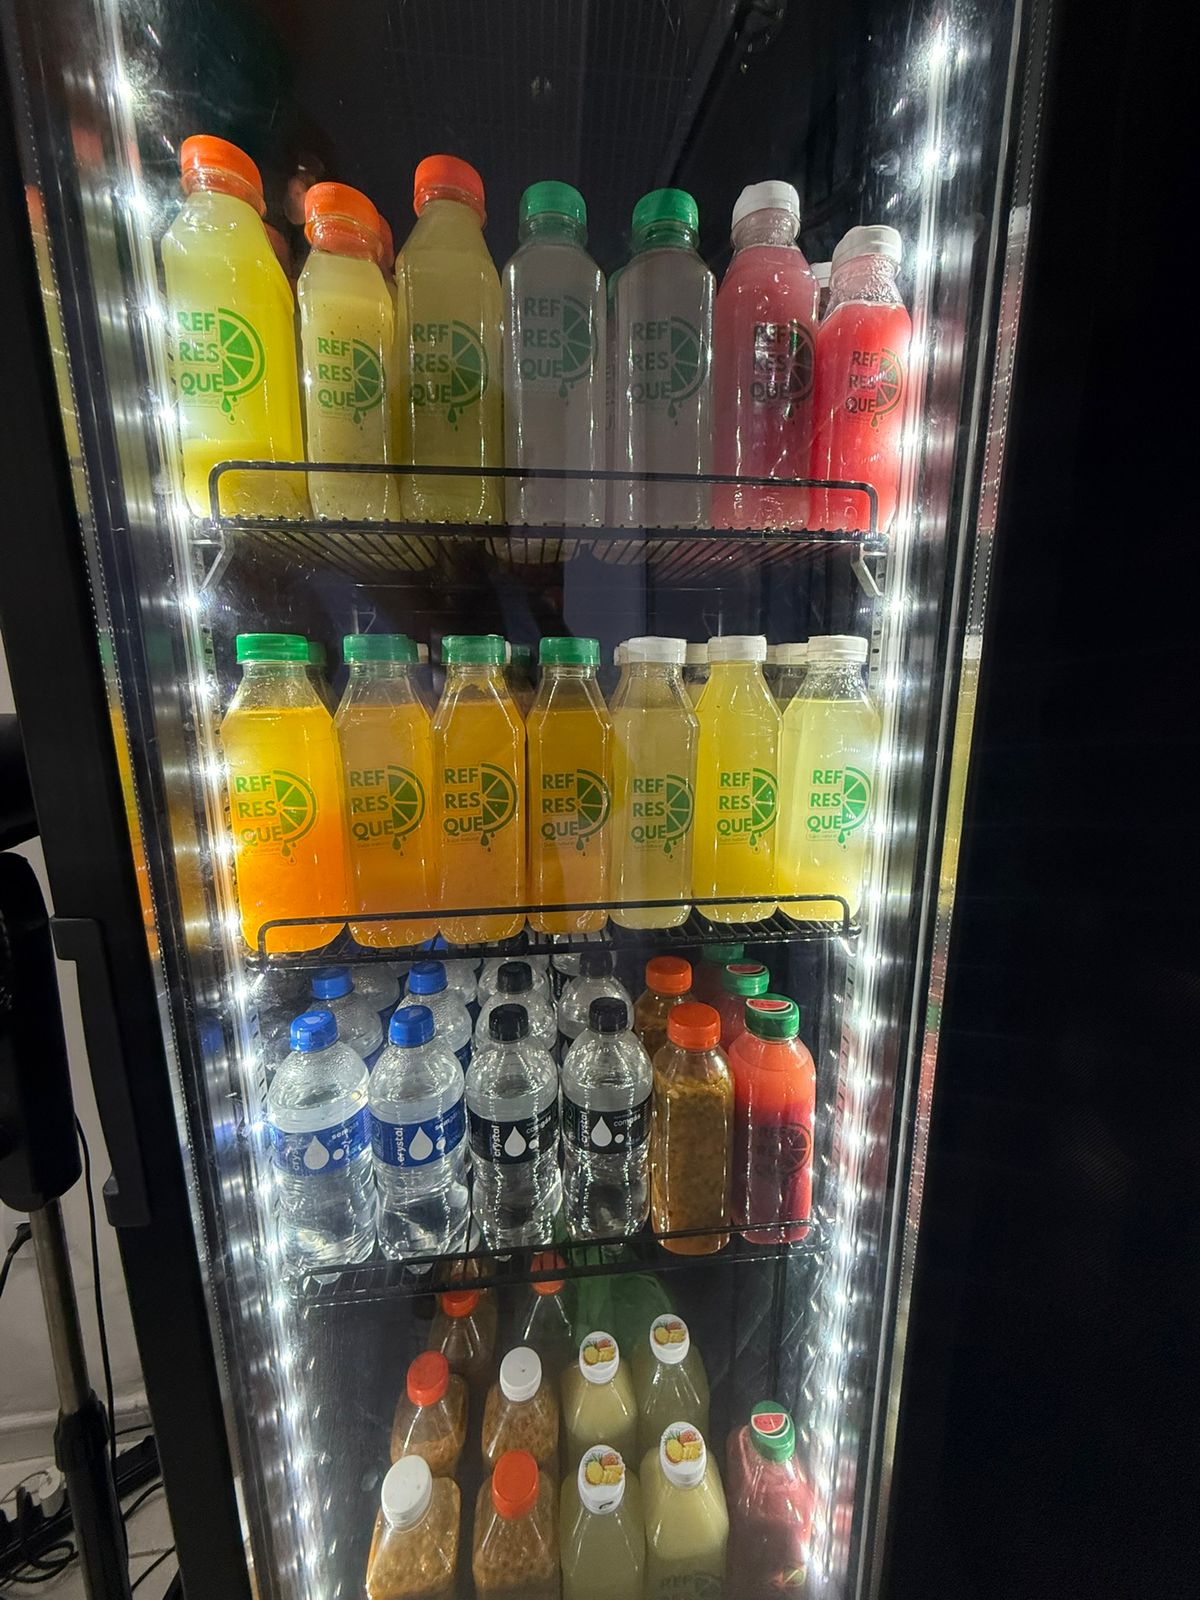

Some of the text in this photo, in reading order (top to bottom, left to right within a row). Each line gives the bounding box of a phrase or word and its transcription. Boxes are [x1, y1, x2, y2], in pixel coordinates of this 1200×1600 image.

[525, 297, 561, 318] REF
[177, 312, 215, 331] REF
[413, 323, 448, 343] REF
[523, 329, 561, 348] RES
[632, 321, 668, 341] REF
[179, 342, 220, 362] RES
[318, 337, 350, 357] REF
[412, 354, 449, 373] RES
[632, 352, 669, 371] RES
[852, 351, 878, 367] REF
[319, 364, 352, 382] RES
[520, 359, 562, 381] QUE
[181, 373, 223, 395] QUE
[850, 375, 875, 390] RES
[318, 389, 355, 408] QUE
[409, 384, 451, 406] QUE
[630, 383, 672, 404] QUE
[846, 397, 876, 413] QUE
[235, 776, 271, 793] REF
[351, 770, 385, 787] REF
[444, 768, 479, 784] REF
[543, 774, 574, 789] REF
[720, 772, 750, 787] REF
[813, 770, 843, 784] REF
[634, 779, 664, 793] REF
[238, 800, 277, 818] RES
[352, 795, 389, 813] RES
[445, 792, 480, 809] RES
[543, 798, 576, 813] RES
[719, 795, 750, 810] RES
[810, 793, 841, 807] RES
[634, 802, 665, 817] RES
[352, 820, 394, 840] QUE
[444, 817, 483, 836] QUE
[541, 822, 578, 840] QUE
[717, 819, 752, 836] QUE
[807, 815, 841, 832] QUE
[240, 826, 282, 846] QUE
[631, 825, 666, 843] QUE
[580, 1111, 590, 1146] crystal
[393, 1127, 406, 1163] crystal
[491, 1125, 502, 1157] crystal
